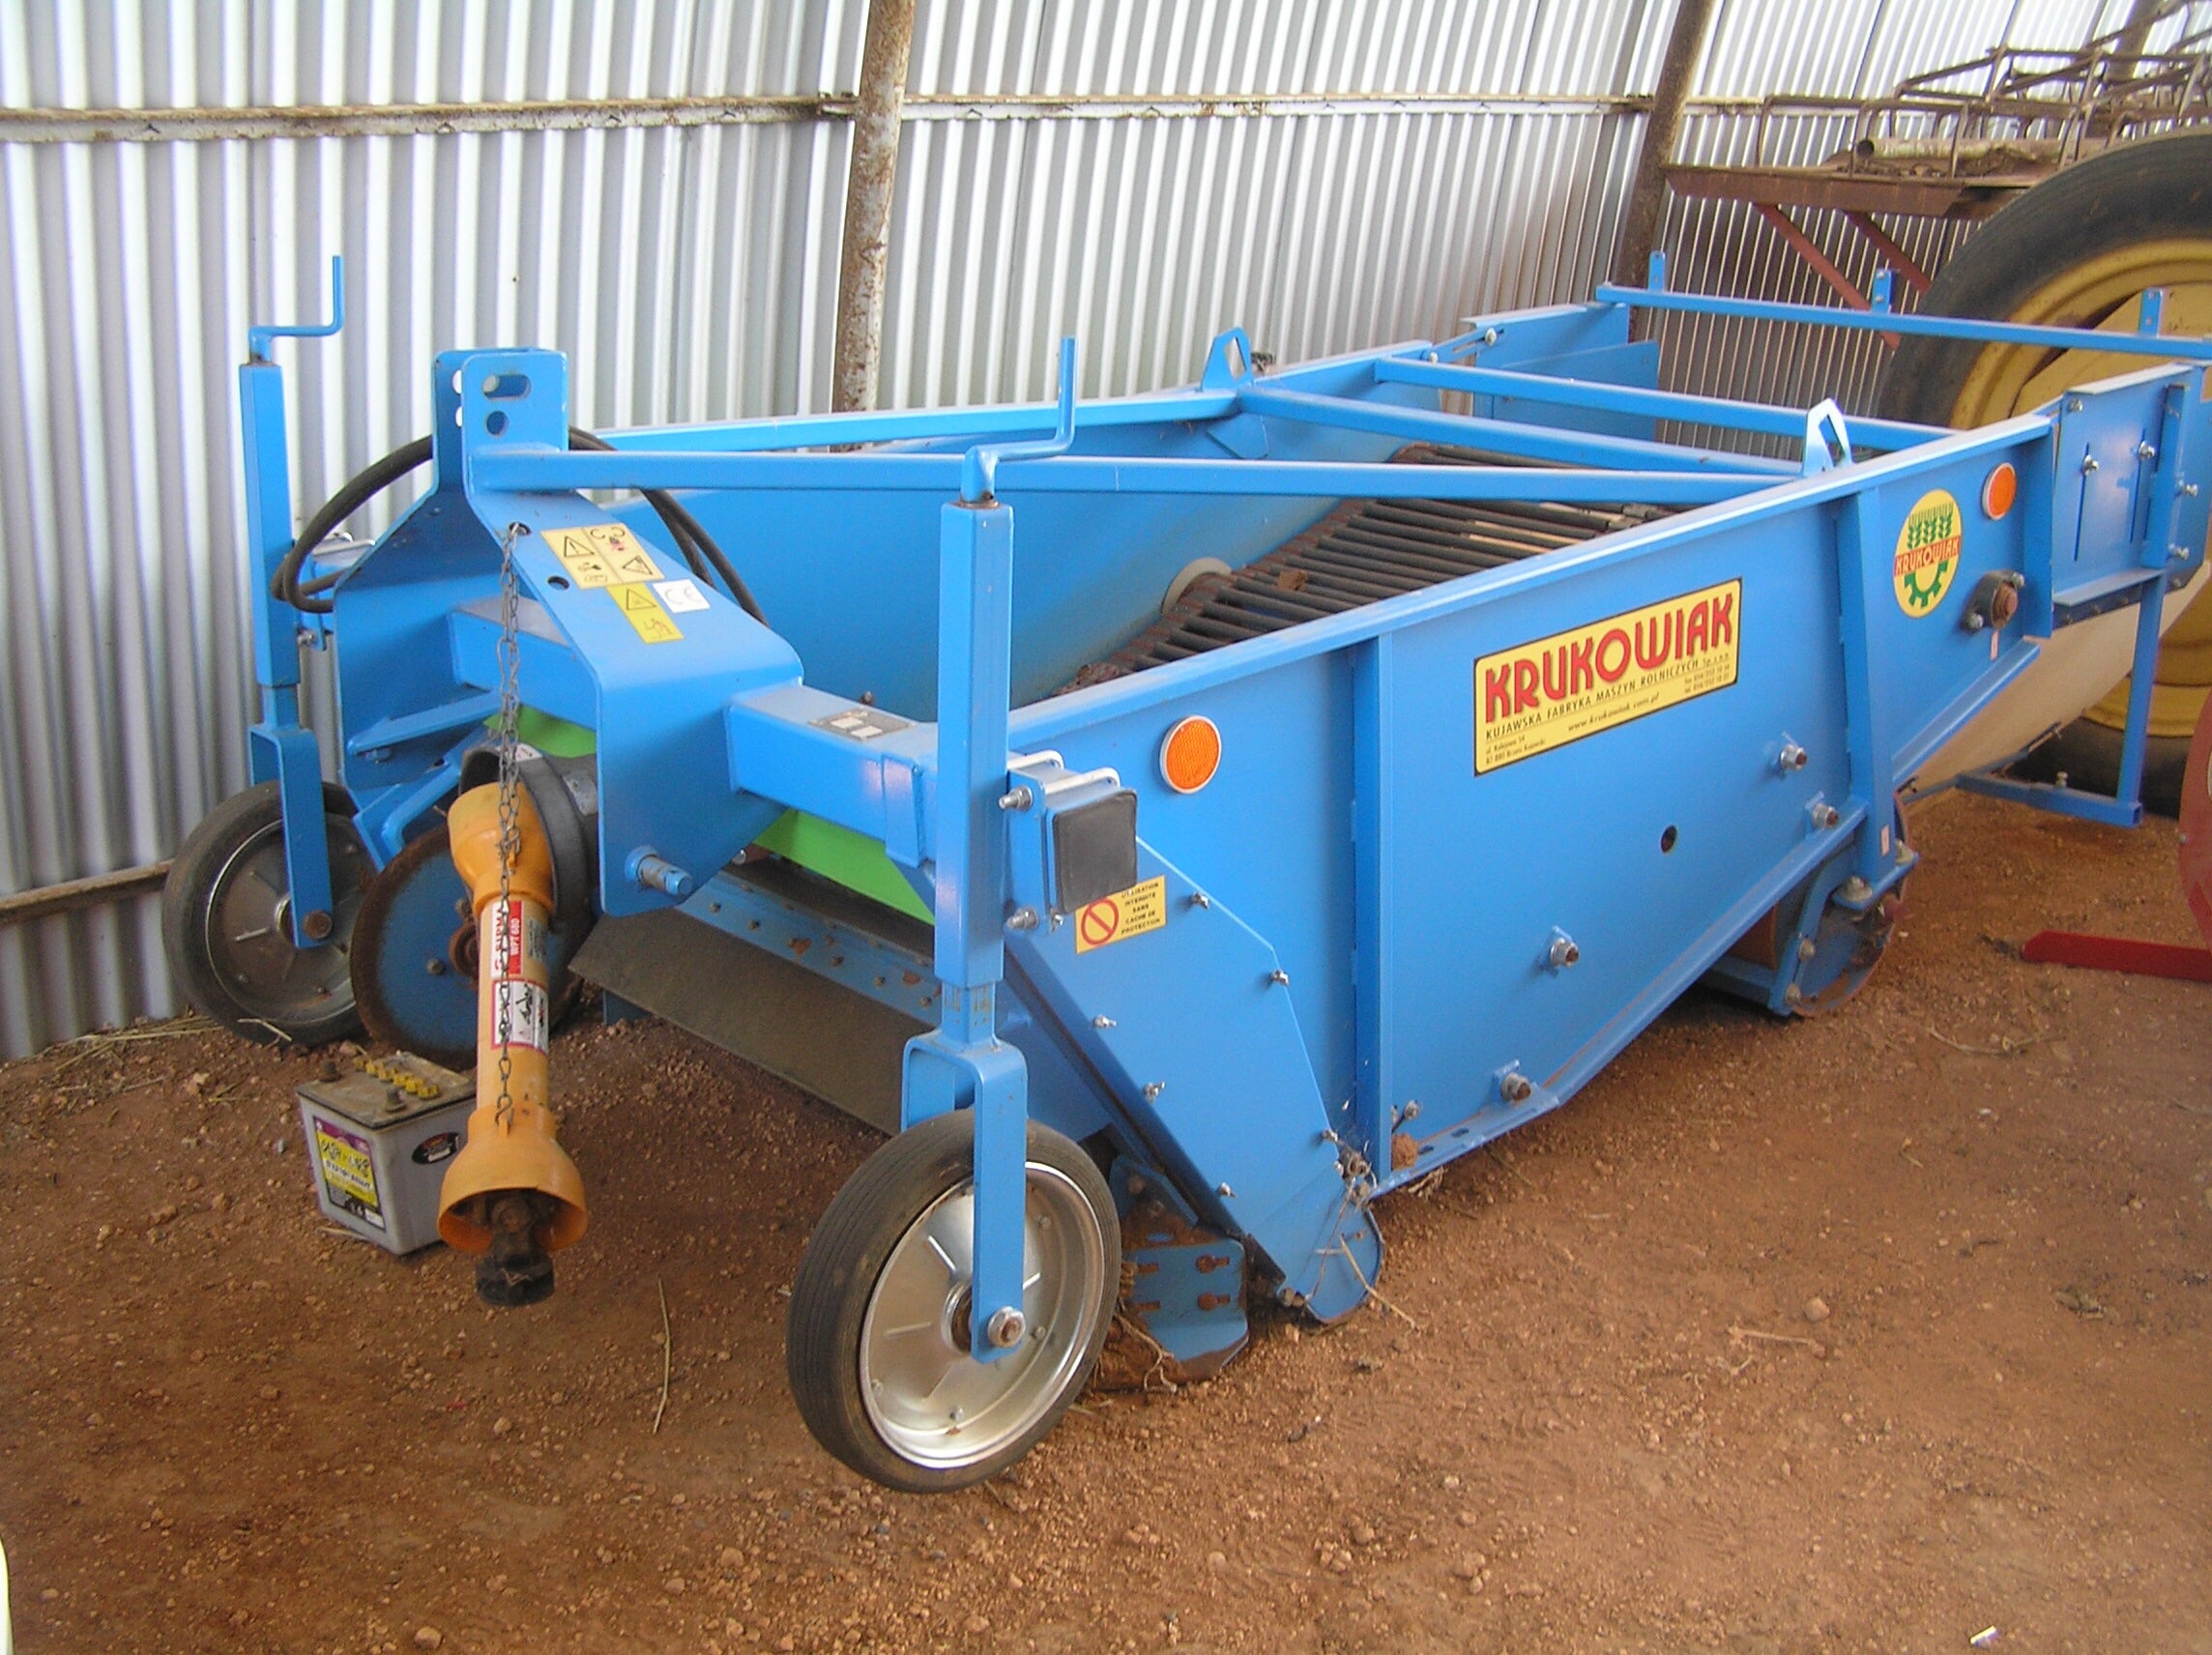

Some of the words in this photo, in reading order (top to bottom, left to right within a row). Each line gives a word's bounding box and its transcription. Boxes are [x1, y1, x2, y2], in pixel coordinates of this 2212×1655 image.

[1895, 538, 1960, 575] KRUKOWIAK
[1485, 592, 1733, 724] KRUKOWIAK
[1486, 713, 1543, 740] KUJAWSKA
[1547, 695, 1591, 722] FABRYKA
[1596, 681, 1636, 703] MASZYN
[1641, 660, 1699, 687] ROLNICZYCH
